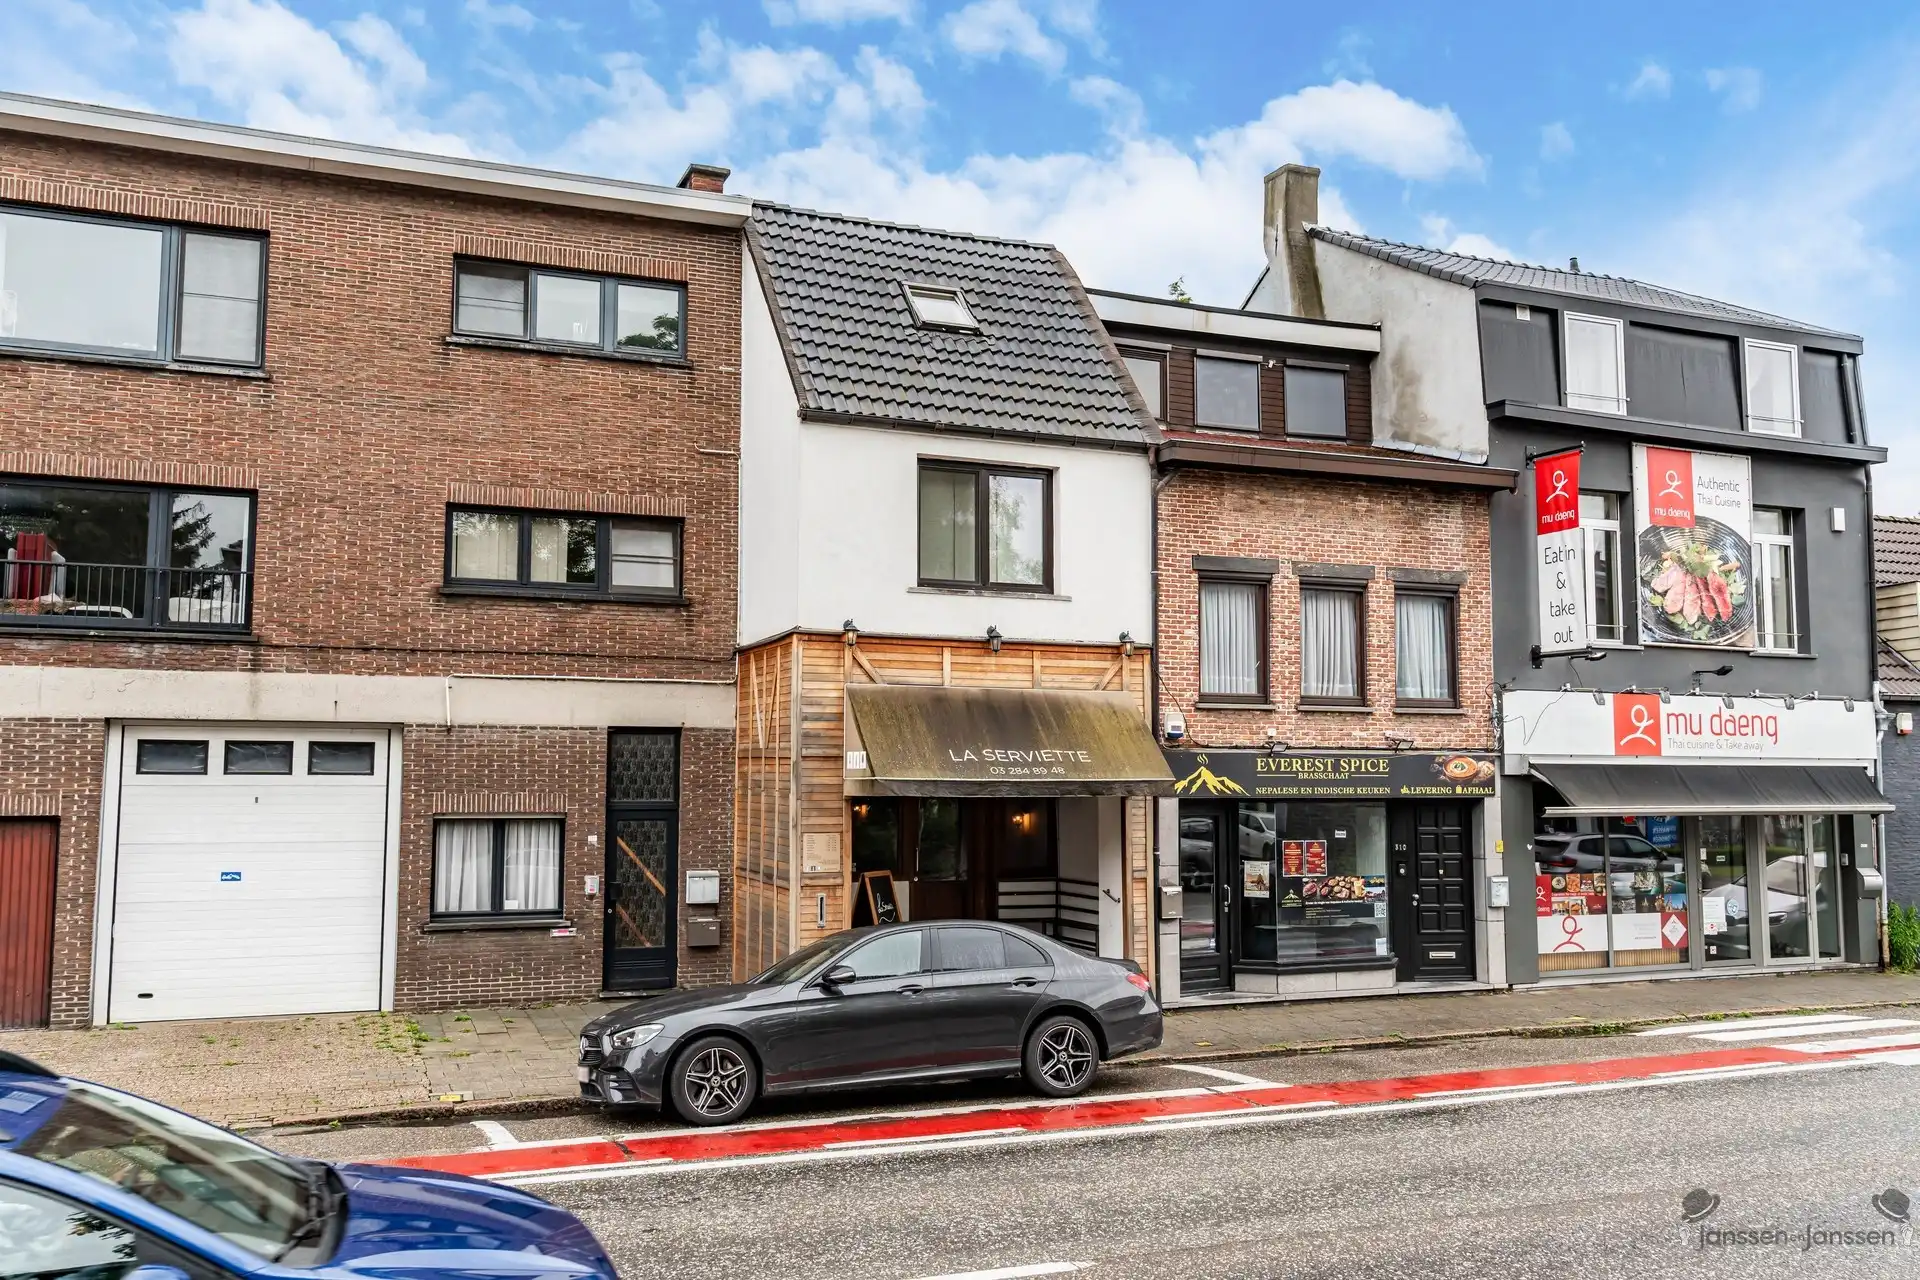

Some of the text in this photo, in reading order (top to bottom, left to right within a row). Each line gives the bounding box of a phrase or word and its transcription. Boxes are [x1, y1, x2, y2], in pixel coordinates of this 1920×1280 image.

[1696, 475, 1740, 493] Authentic
[1697, 493, 1741, 508] Thai Cuisine
[1541, 509, 1575, 524] mu daeng
[1654, 506, 1691, 520] mu daeng
[1544, 545, 1576, 565] Eat in
[1556, 571, 1567, 590] &
[1549, 598, 1576, 618] take
[1553, 626, 1574, 644] out
[1666, 706, 1778, 745] mu daeng
[1667, 737, 1764, 752] Thai cuisine & Take away
[948, 748, 1092, 763] LA SERVIETTE
[989, 766, 1066, 775] 03 284 89 48
[1256, 757, 1390, 773] EVEREST SPICE
[1298, 772, 1350, 780] BRASSCHAAT
[1255, 786, 1391, 795] NEPALESE EN INDISCHE KEUKEN
[1411, 786, 1495, 794] LEVERING AFHAAL
[1394, 843, 1407, 851] 310
